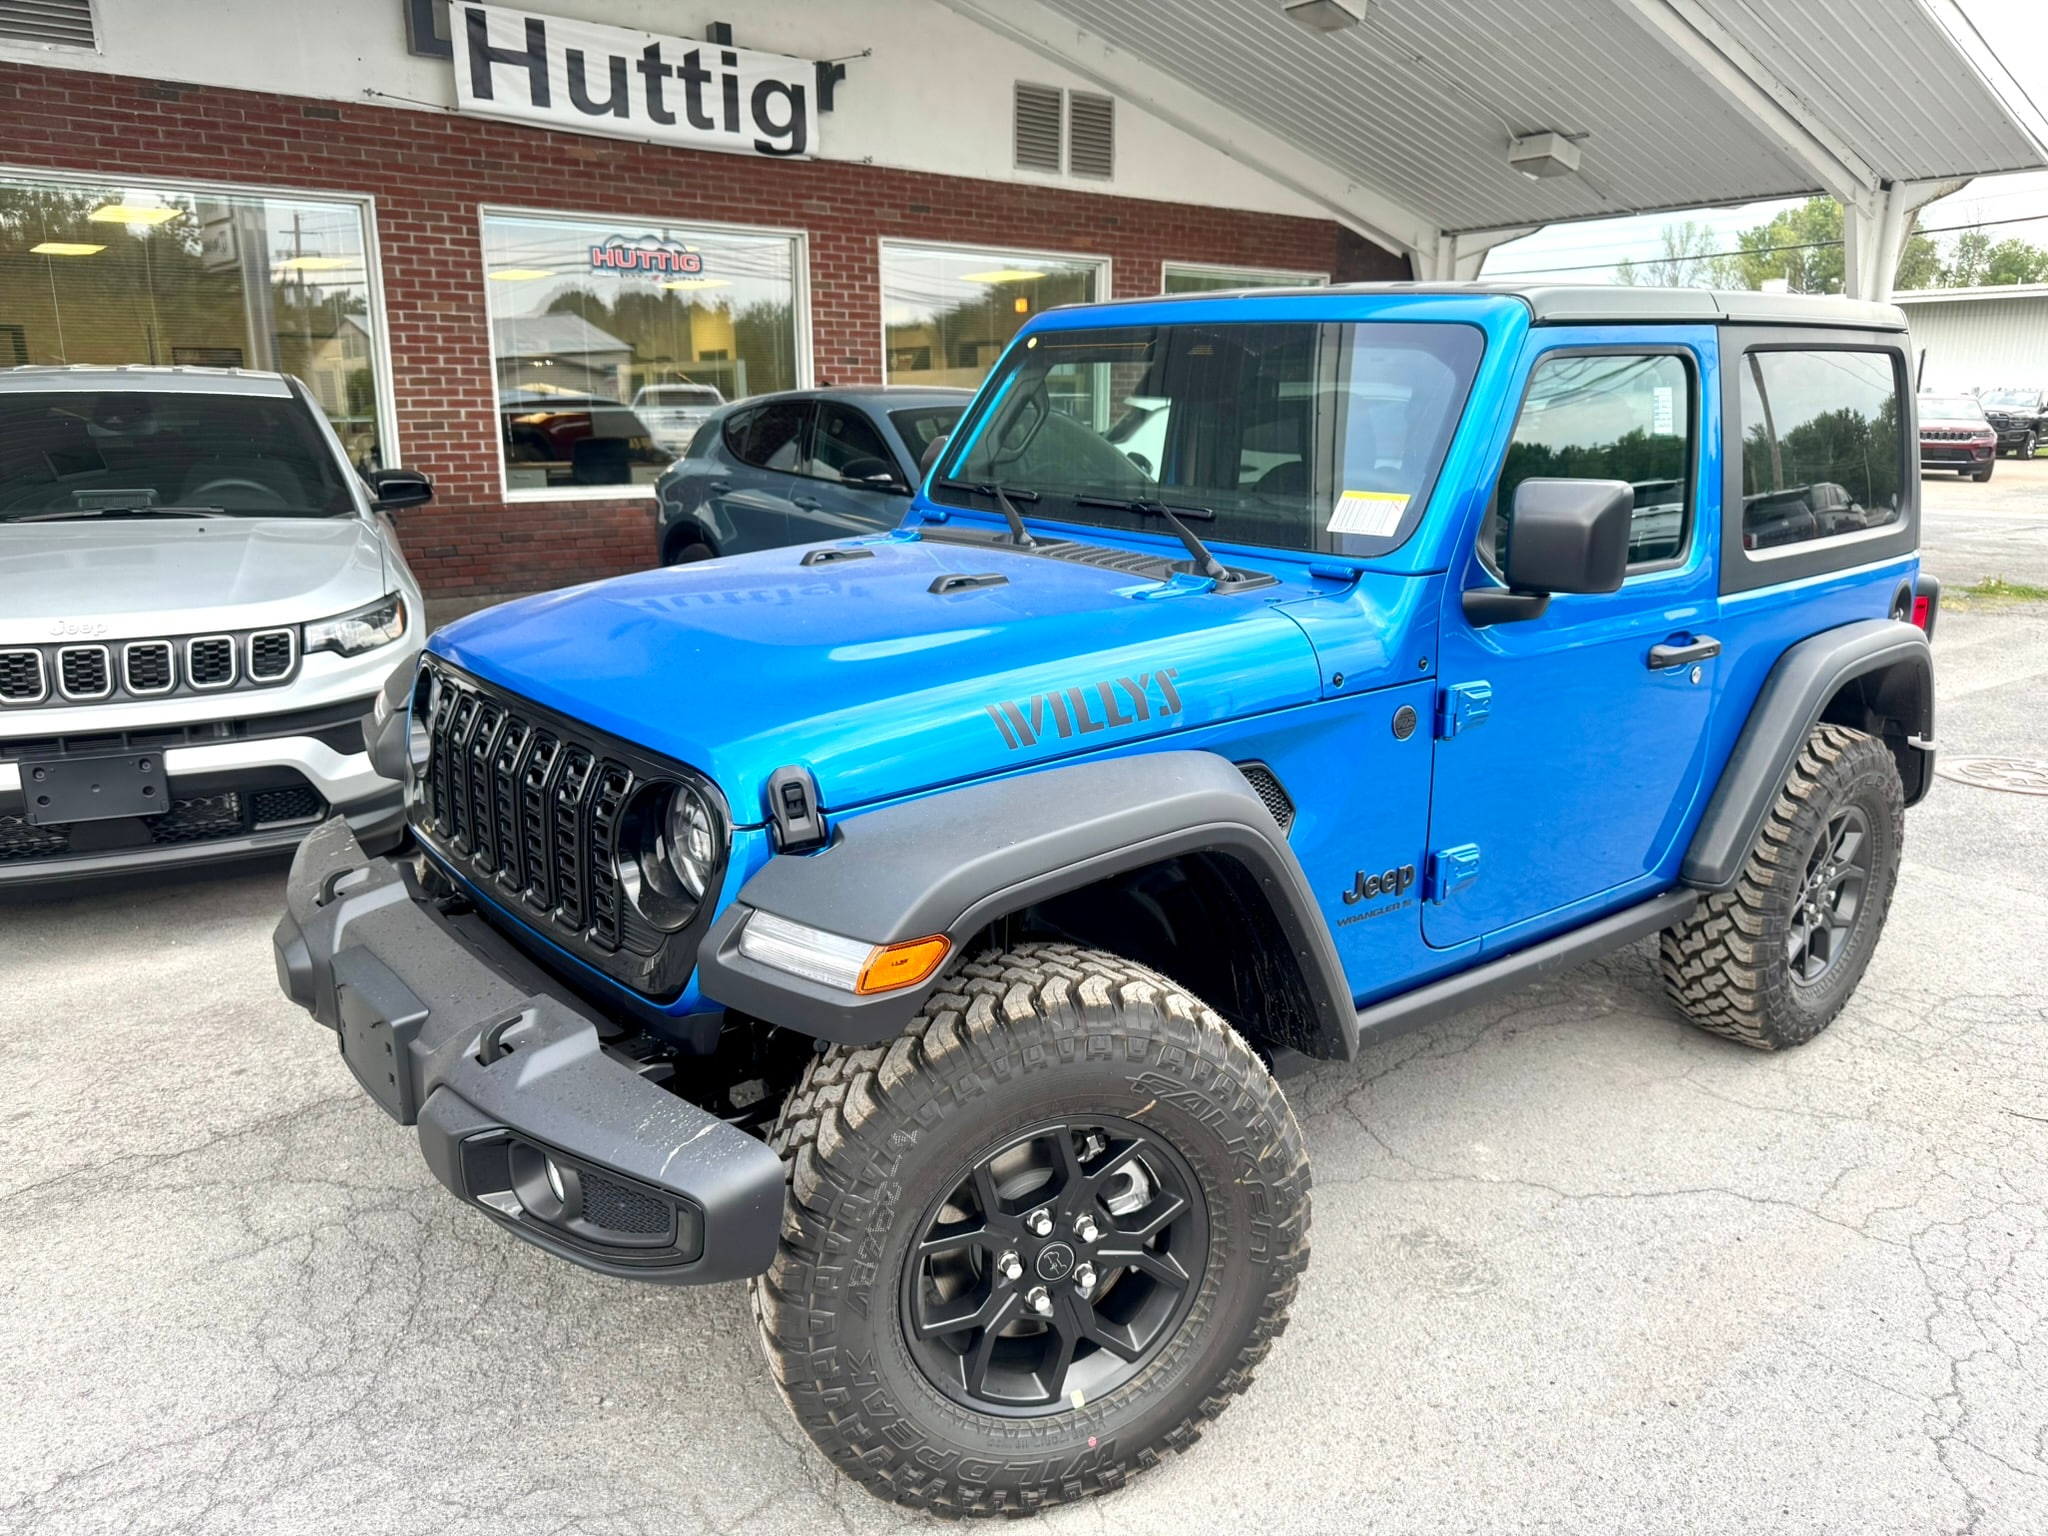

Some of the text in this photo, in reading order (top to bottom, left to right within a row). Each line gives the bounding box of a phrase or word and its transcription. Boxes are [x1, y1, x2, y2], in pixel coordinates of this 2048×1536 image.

[465, 6, 807, 157] Huttig
[592, 247, 701, 273] HUTTIG
[49, 620, 108, 637] Jeep
[984, 667, 1182, 750] WILLYS
[1343, 863, 1415, 905] Jeep
[1337, 903, 1401, 928] WRANGLER
[844, 1347, 1118, 1488] WILDPEAK
